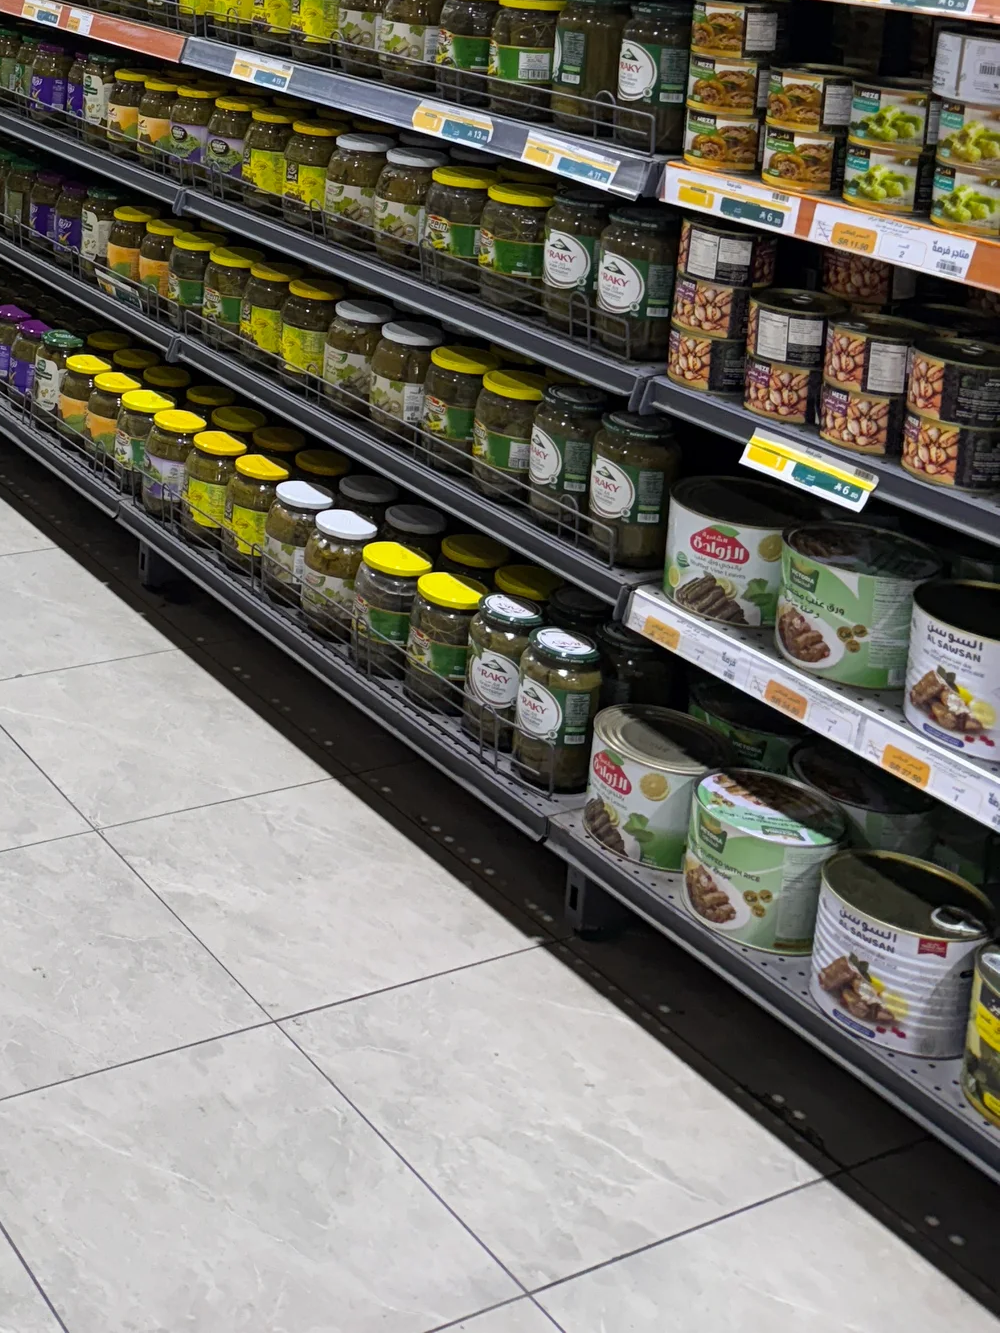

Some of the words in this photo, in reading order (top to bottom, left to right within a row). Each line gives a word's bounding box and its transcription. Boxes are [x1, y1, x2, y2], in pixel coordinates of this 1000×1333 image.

[620, 61, 643, 73] RAKY
[698, 60, 714, 68] MEZE
[861, 91, 879, 100] MEZE
[697, 116, 715, 125] MEZE
[549, 250, 576, 264] RAKY
[951, 247, 970, 260] متاجر
[602, 271, 630, 288] RAKY
[832, 391, 848, 402] MEZE
[594, 475, 621, 493] RAKY
[693, 536, 745, 561] الزوادة
[806, 596, 824, 609] عنب
[827, 603, 845, 616] ورق
[928, 621, 983, 652] السوسن
[937, 638, 981, 663] SAWSAN
[481, 669, 512, 684] RAKY
[522, 695, 548, 715] RAKY
[724, 863, 742, 877] WITH
[743, 870, 761, 883] RICE
[839, 907, 898, 943] السوسن
[838, 919, 851, 932] AL
[851, 926, 896, 954] SAWSAN
